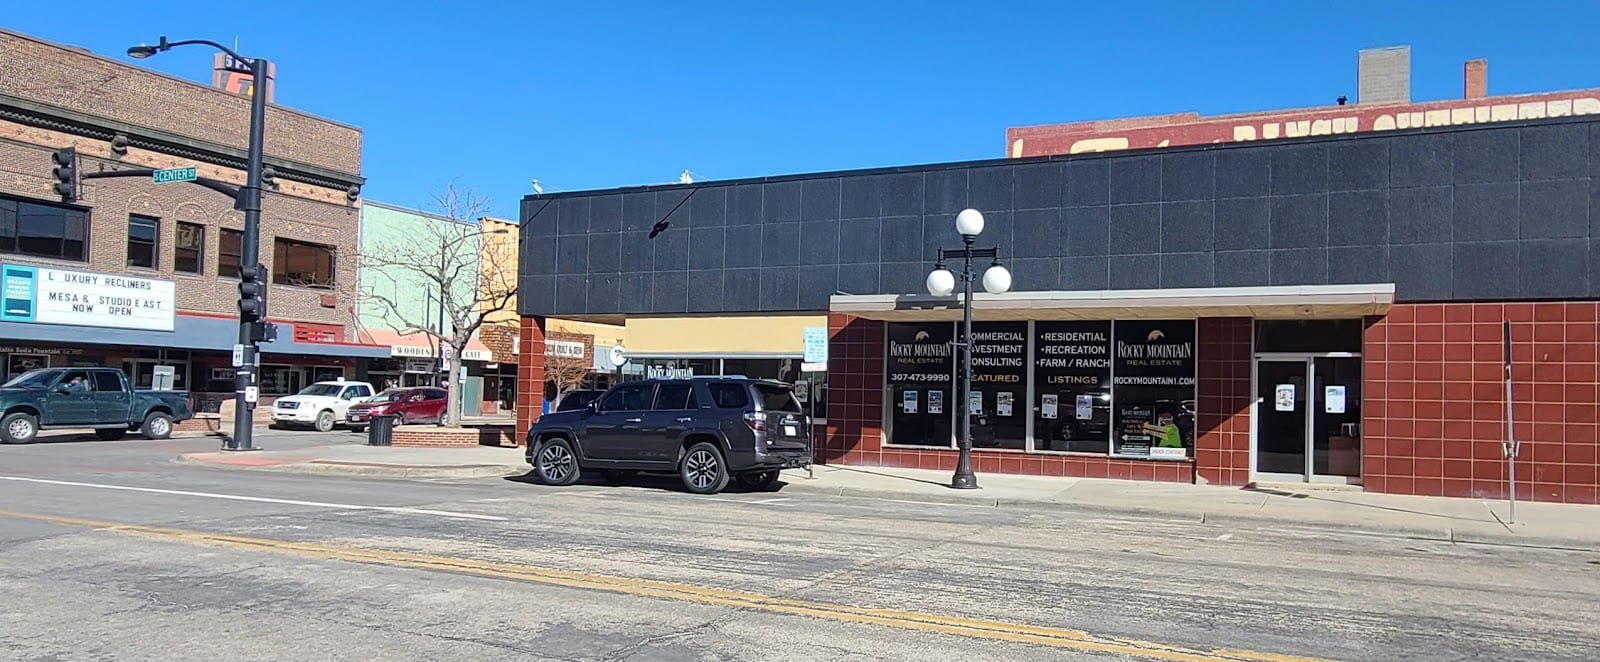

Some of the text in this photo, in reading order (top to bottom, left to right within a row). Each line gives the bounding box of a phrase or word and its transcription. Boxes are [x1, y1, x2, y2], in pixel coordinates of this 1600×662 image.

[159, 169, 188, 182] CENTER
[105, 278, 152, 290] RECLINERS
[48, 292, 79, 303] MESA
[82, 295, 89, 303] &
[99, 296, 132, 307] STUDIO
[72, 304, 132, 316] NOW OPEN
[970, 332, 1024, 341] OMMERCIAL
[1044, 332, 1107, 341] RESIDENTIAL
[890, 340, 952, 357] ROCKY MOUNTAIN
[971, 345, 1023, 353] VESTMENT
[1045, 345, 1105, 354] RECREATION
[1118, 340, 1191, 358] ROCKY MOUNTAIN
[971, 357, 1022, 366] ONSULTING
[1040, 359, 1066, 368] FARM
[1075, 359, 1110, 368] RANCH
[891, 373, 950, 381] 307-473-9990
[970, 374, 1020, 382] EATURED
[1047, 376, 1098, 384] LISTINGS
[1114, 376, 1195, 385] ROCKYMOUNTAIN1.COM
